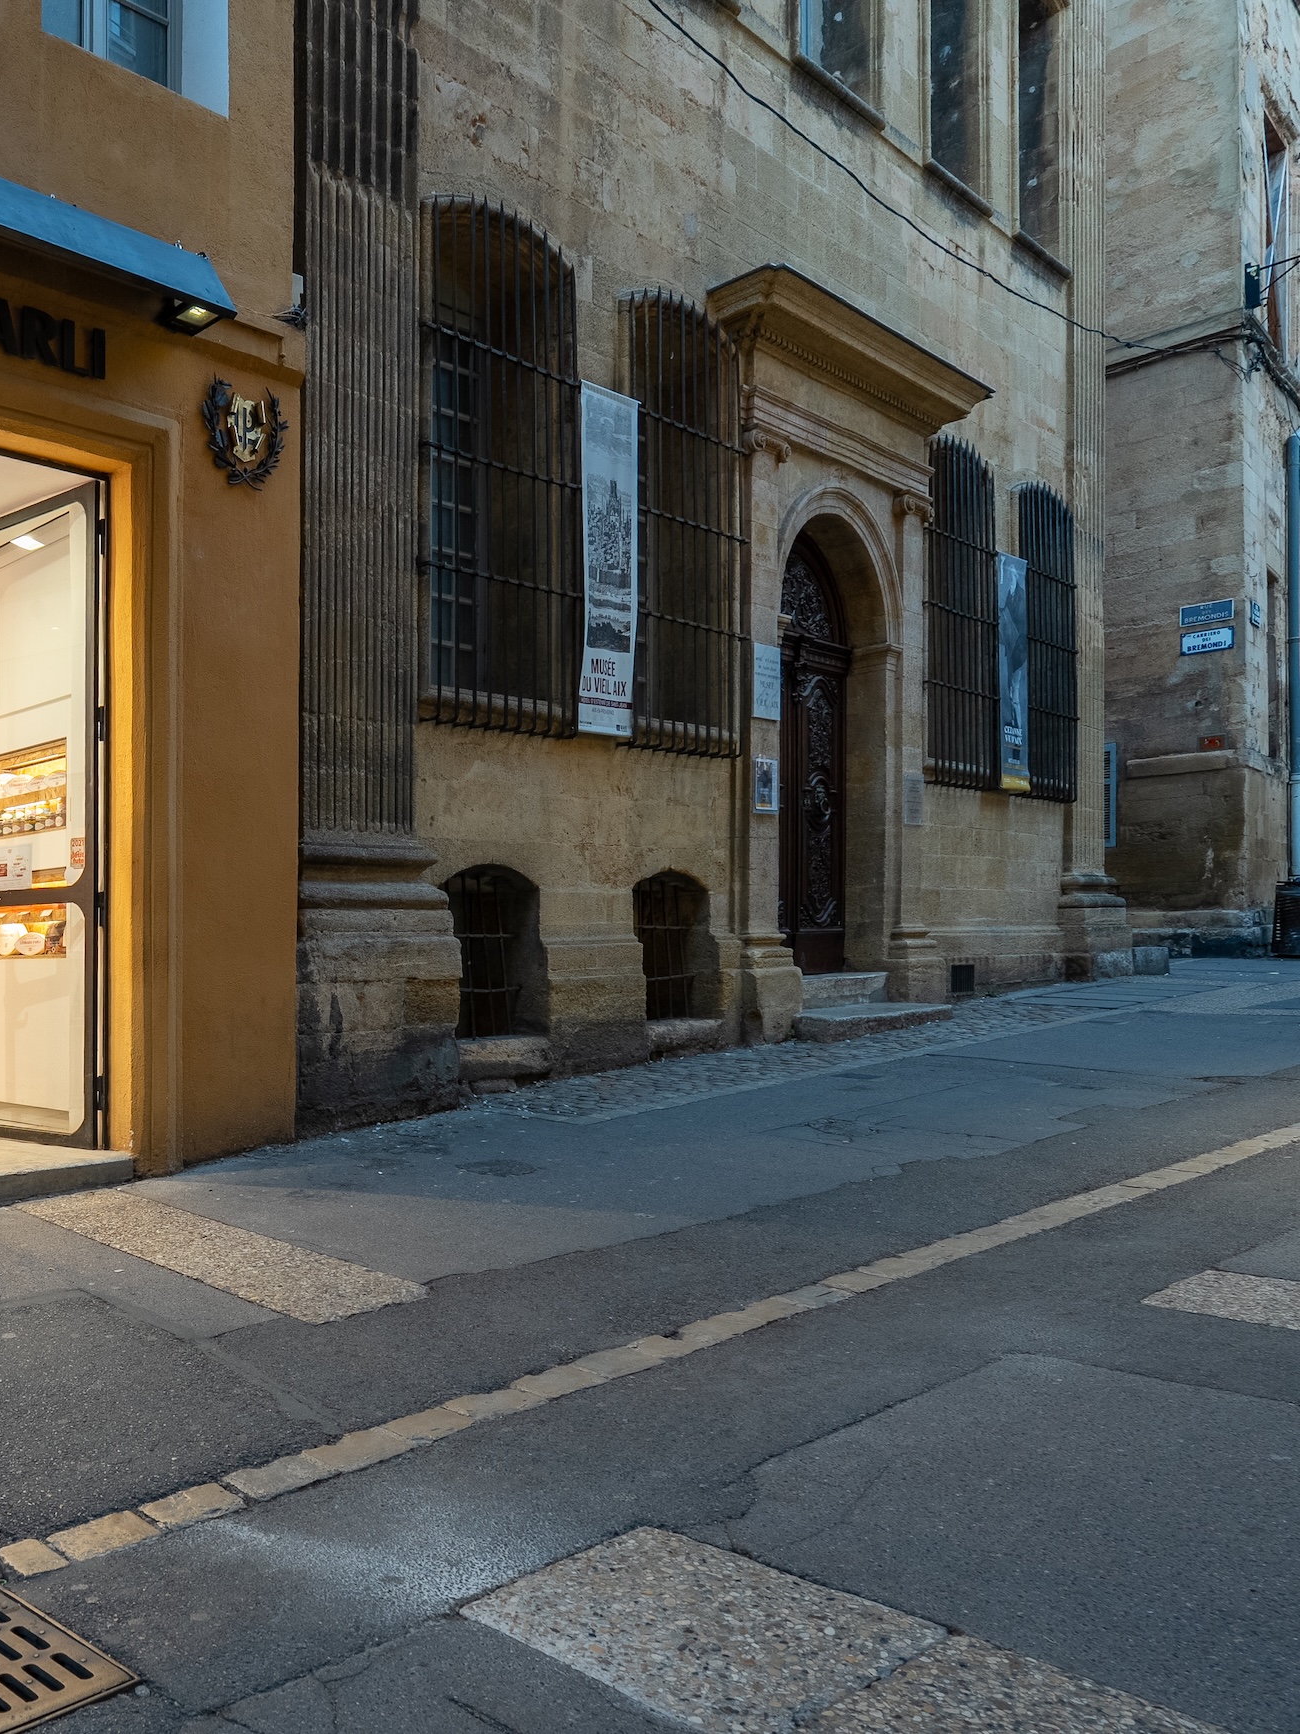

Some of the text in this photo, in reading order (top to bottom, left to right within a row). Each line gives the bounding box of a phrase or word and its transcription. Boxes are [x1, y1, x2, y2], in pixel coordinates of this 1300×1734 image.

[1183, 610, 1230, 624] BREMONDIS
[1186, 640, 1227, 652] BREMONDI
[591, 657, 616, 677] MUSÉE
[612, 681, 627, 697] AIX
